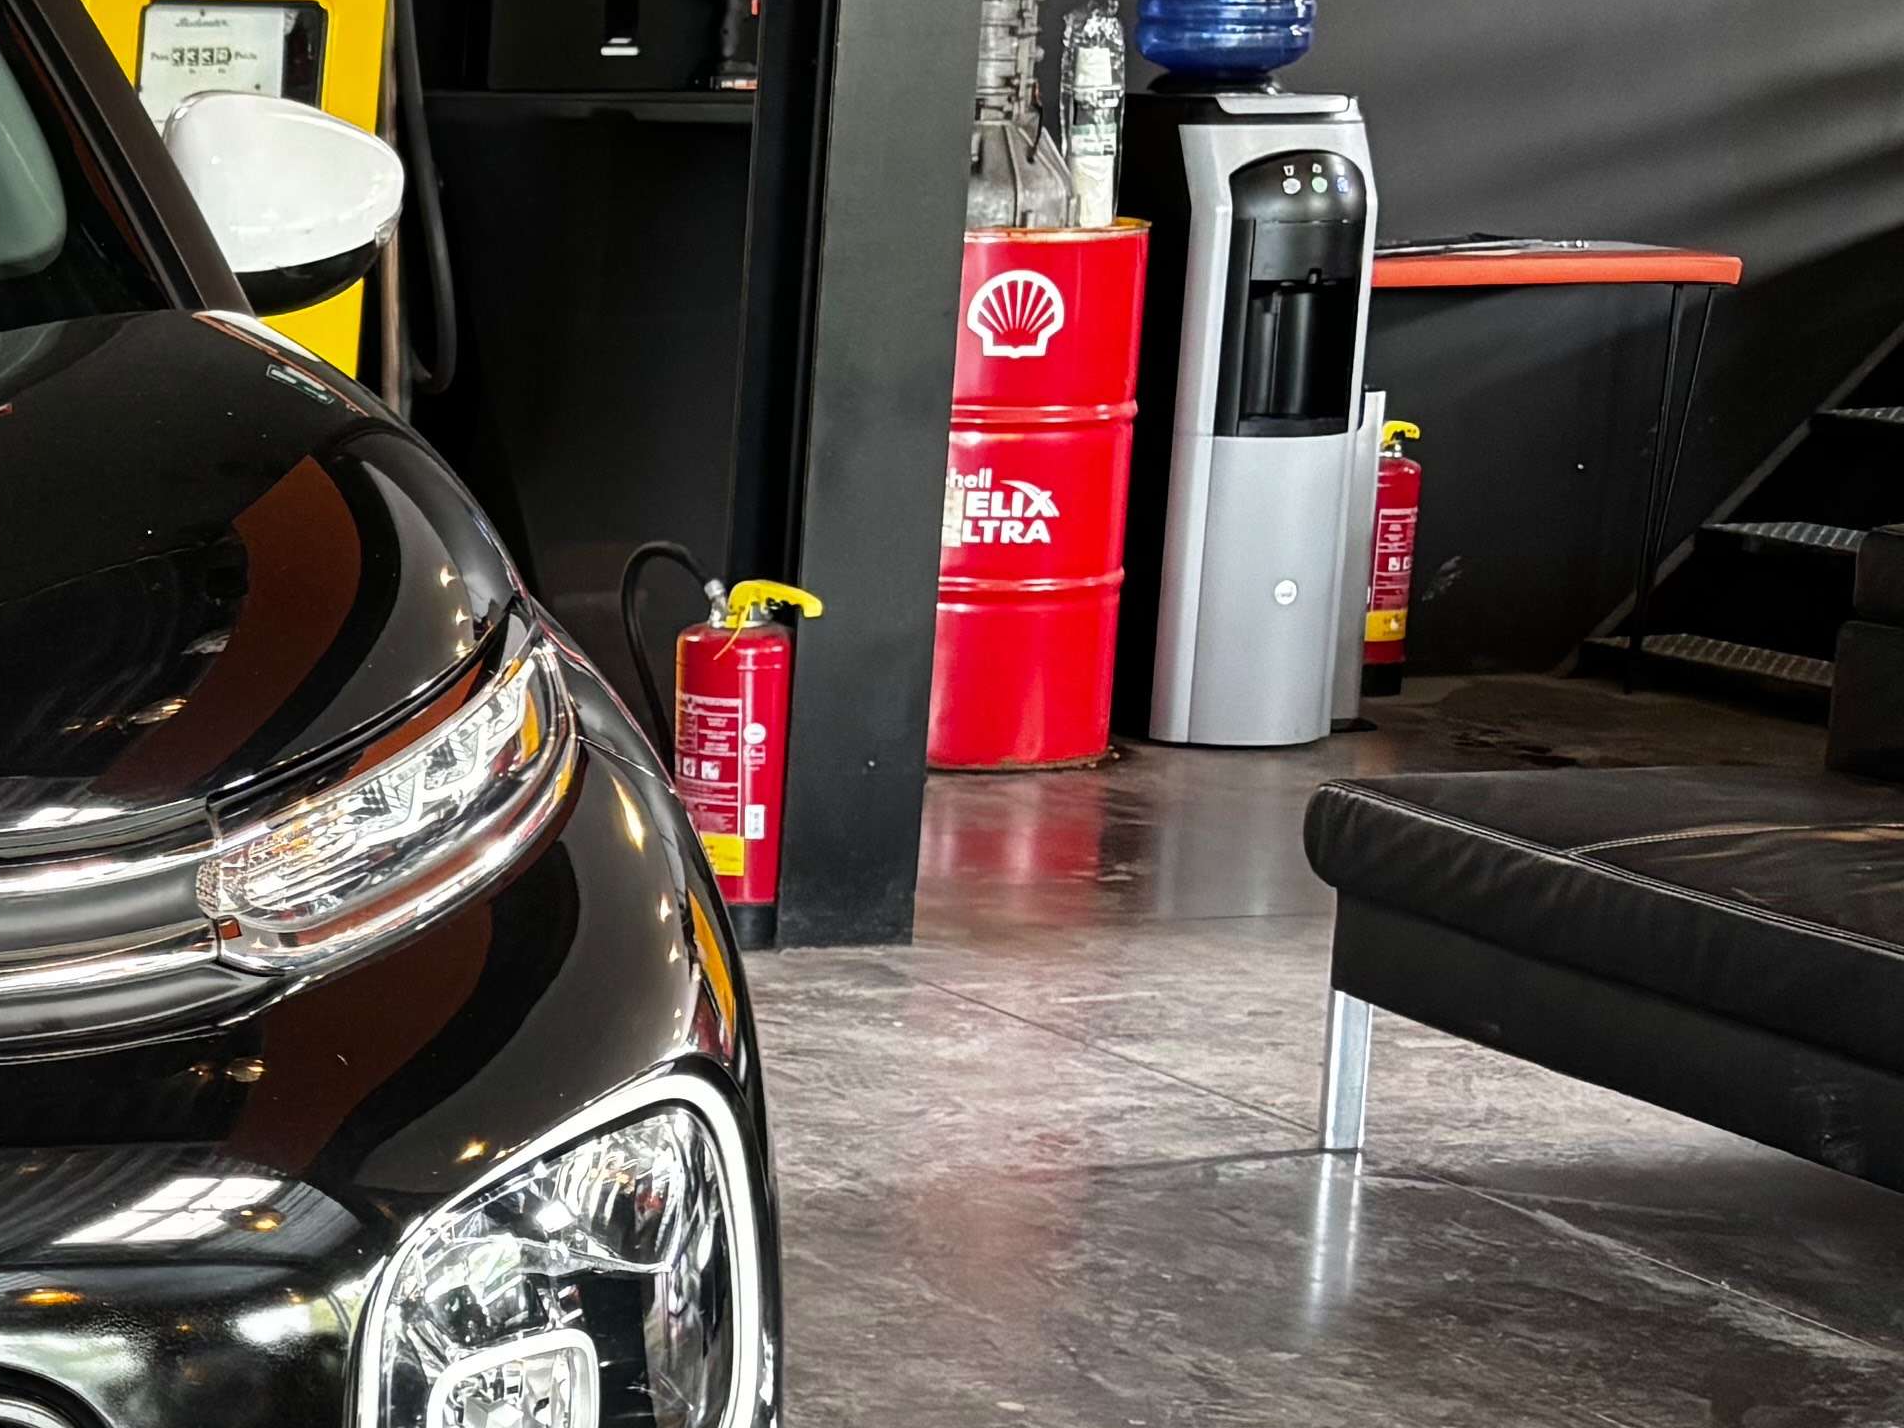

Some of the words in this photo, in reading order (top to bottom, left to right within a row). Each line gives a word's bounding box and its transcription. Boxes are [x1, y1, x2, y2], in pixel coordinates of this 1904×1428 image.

[946, 467, 992, 489] hell
[962, 479, 1061, 518] ELIX
[958, 519, 1051, 544] LTRA
